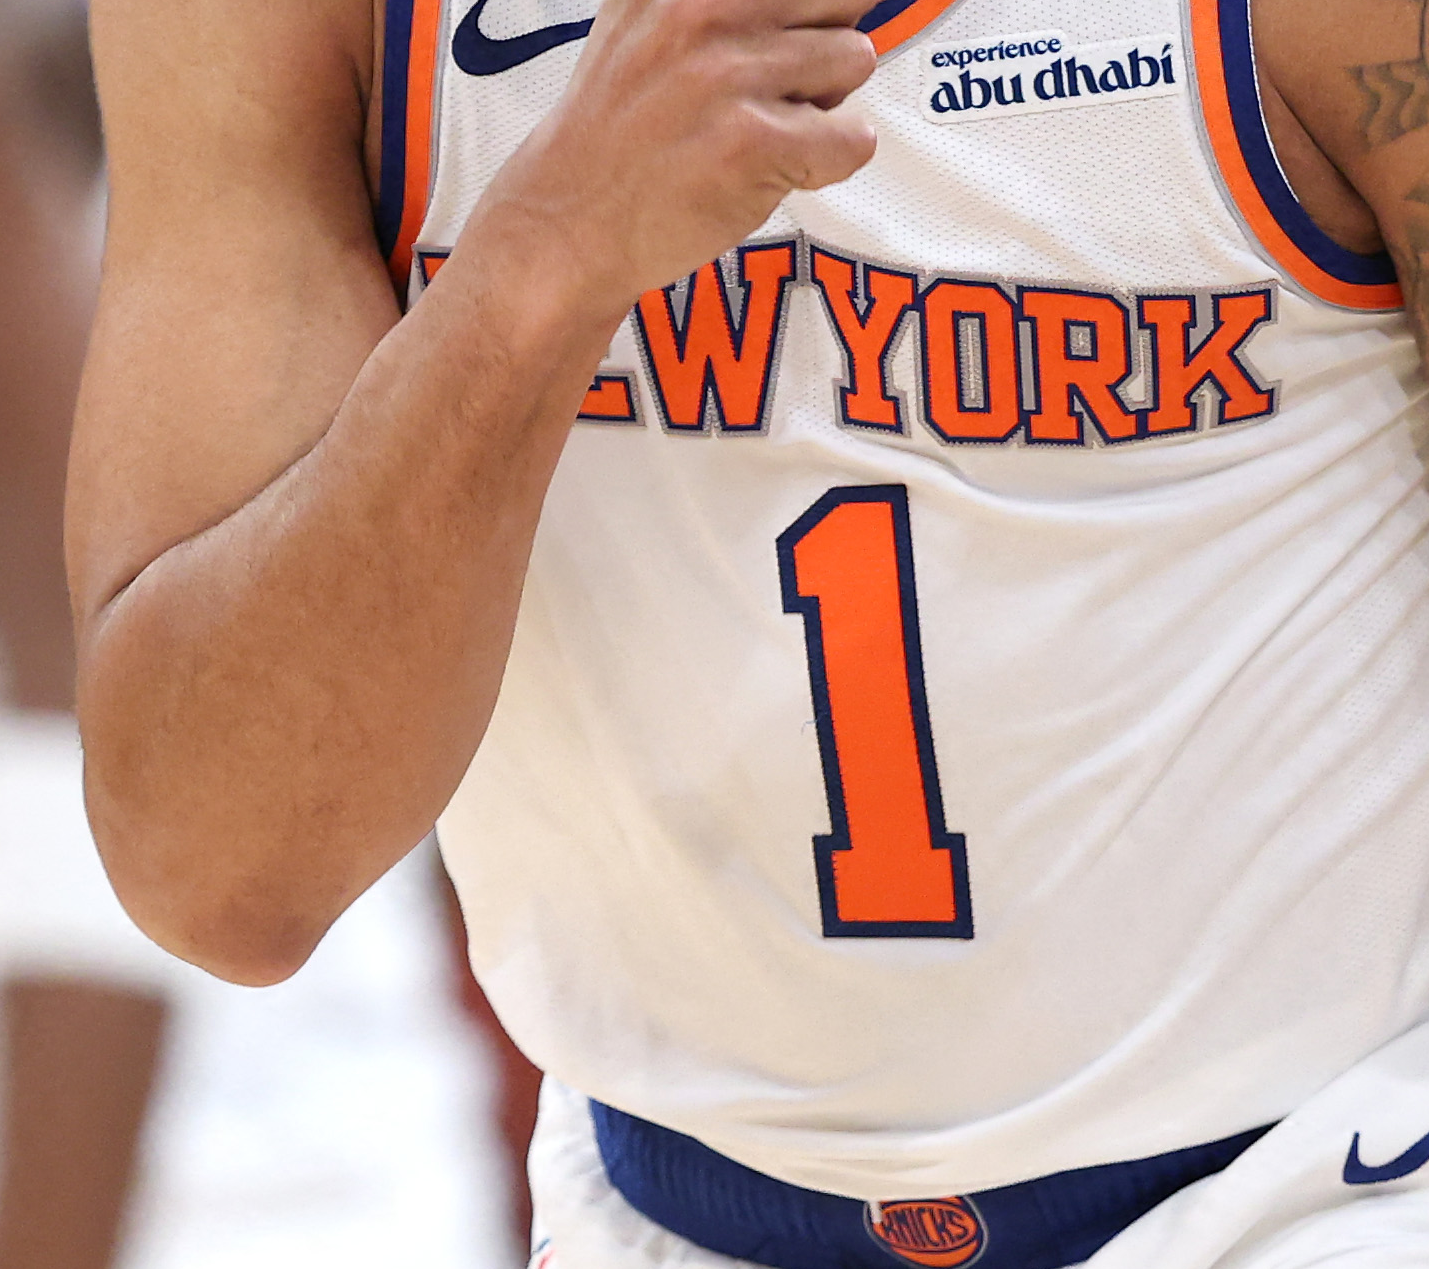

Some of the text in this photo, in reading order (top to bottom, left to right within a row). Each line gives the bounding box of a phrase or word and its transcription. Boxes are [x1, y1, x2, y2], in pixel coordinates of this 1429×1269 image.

[930, 68, 1026, 114] abu
[931, 35, 1062, 68] experience
[811, 246, 1277, 444] YORK
[775, 484, 974, 939] 1
